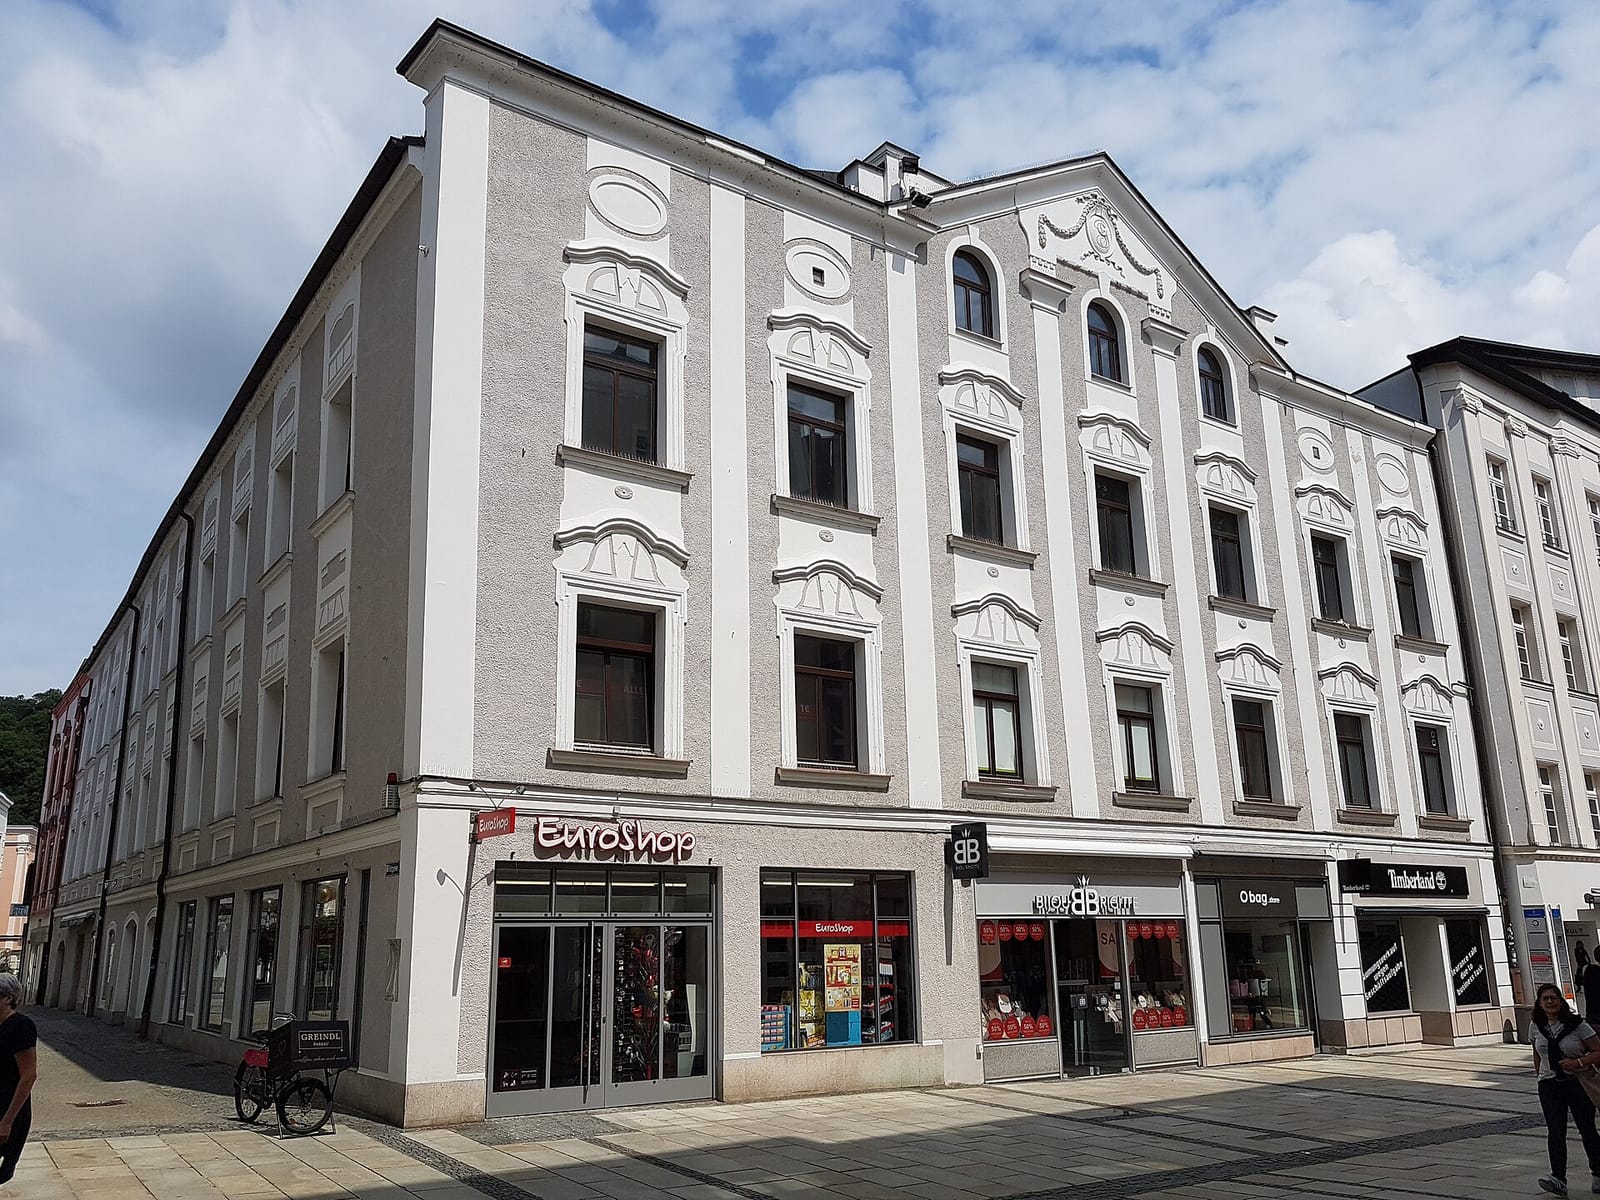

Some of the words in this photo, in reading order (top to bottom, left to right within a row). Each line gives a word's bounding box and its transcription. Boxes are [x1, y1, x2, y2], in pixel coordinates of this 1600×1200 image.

[479, 816, 509, 833] EuroShop
[535, 815, 697, 861] EuroShop
[1387, 869, 1436, 890] Timberland
[815, 923, 854, 934] EuroShop
[1101, 932, 1116, 945] SA
[301, 1033, 341, 1041] GREINDL
